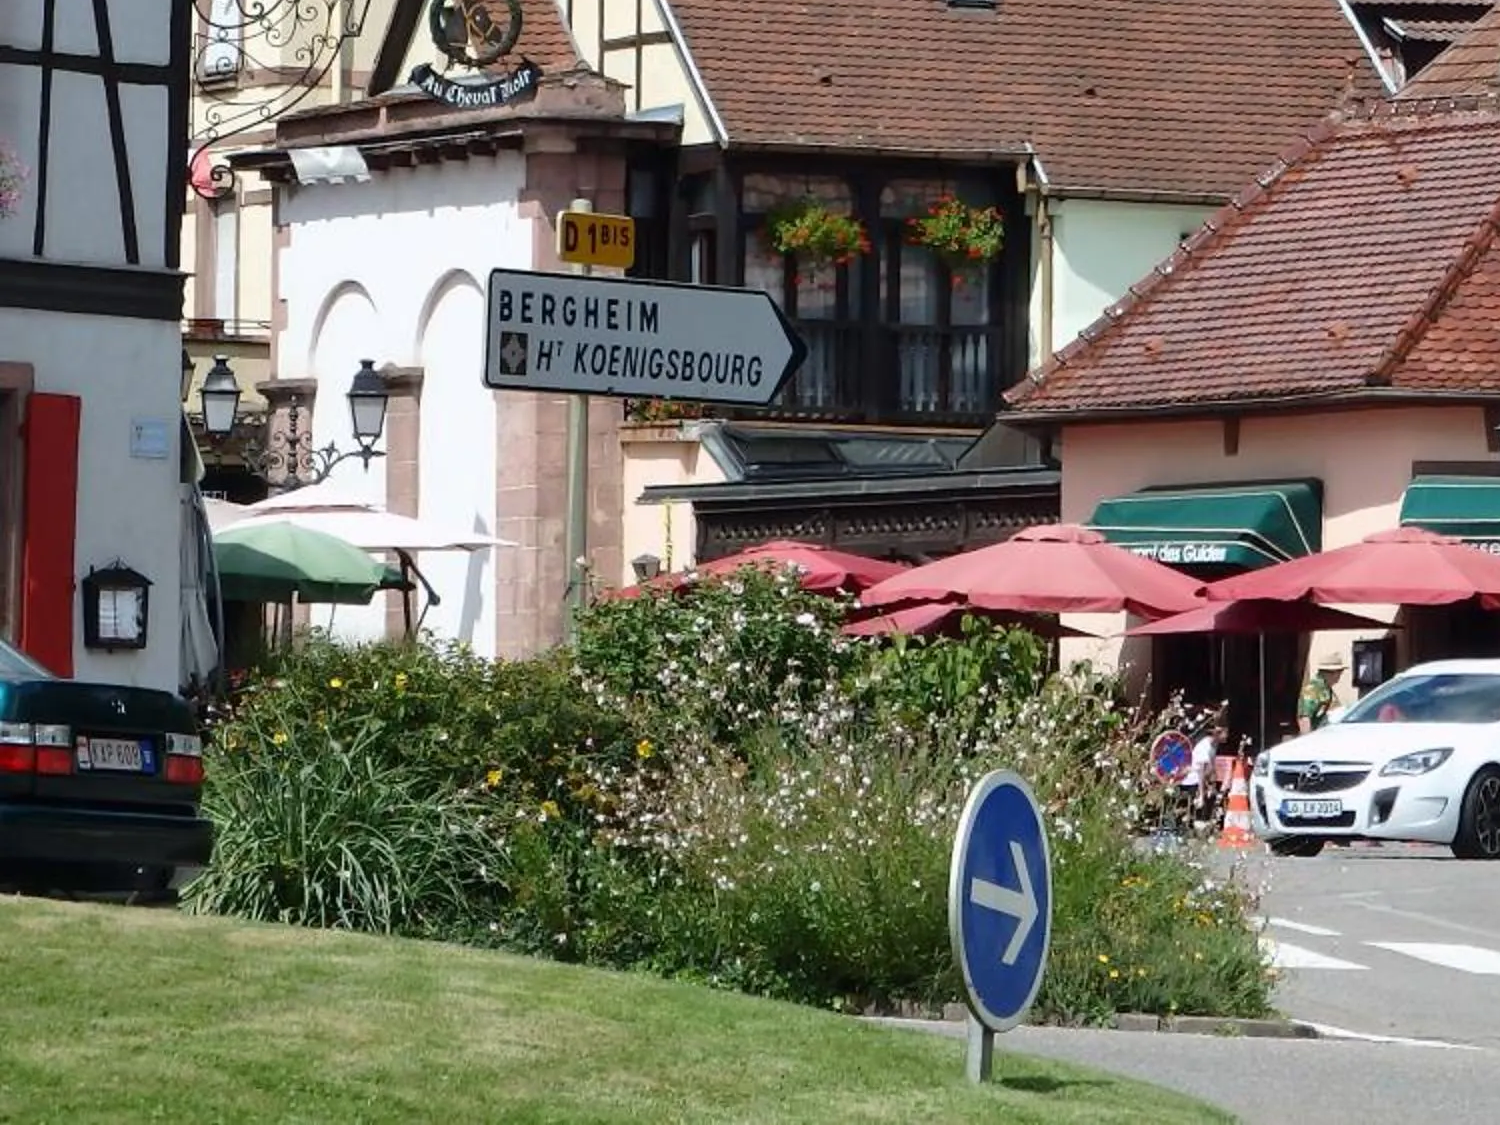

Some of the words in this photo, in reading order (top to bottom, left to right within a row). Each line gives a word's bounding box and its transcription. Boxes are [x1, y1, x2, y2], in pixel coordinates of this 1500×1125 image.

[422, 75, 442, 97] Au
[446, 84, 497, 107] Cheval
[565, 221, 578, 252] D
[500, 291, 659, 333] BERGHEIM
[574, 342, 763, 387] KOENIGSBOURG
